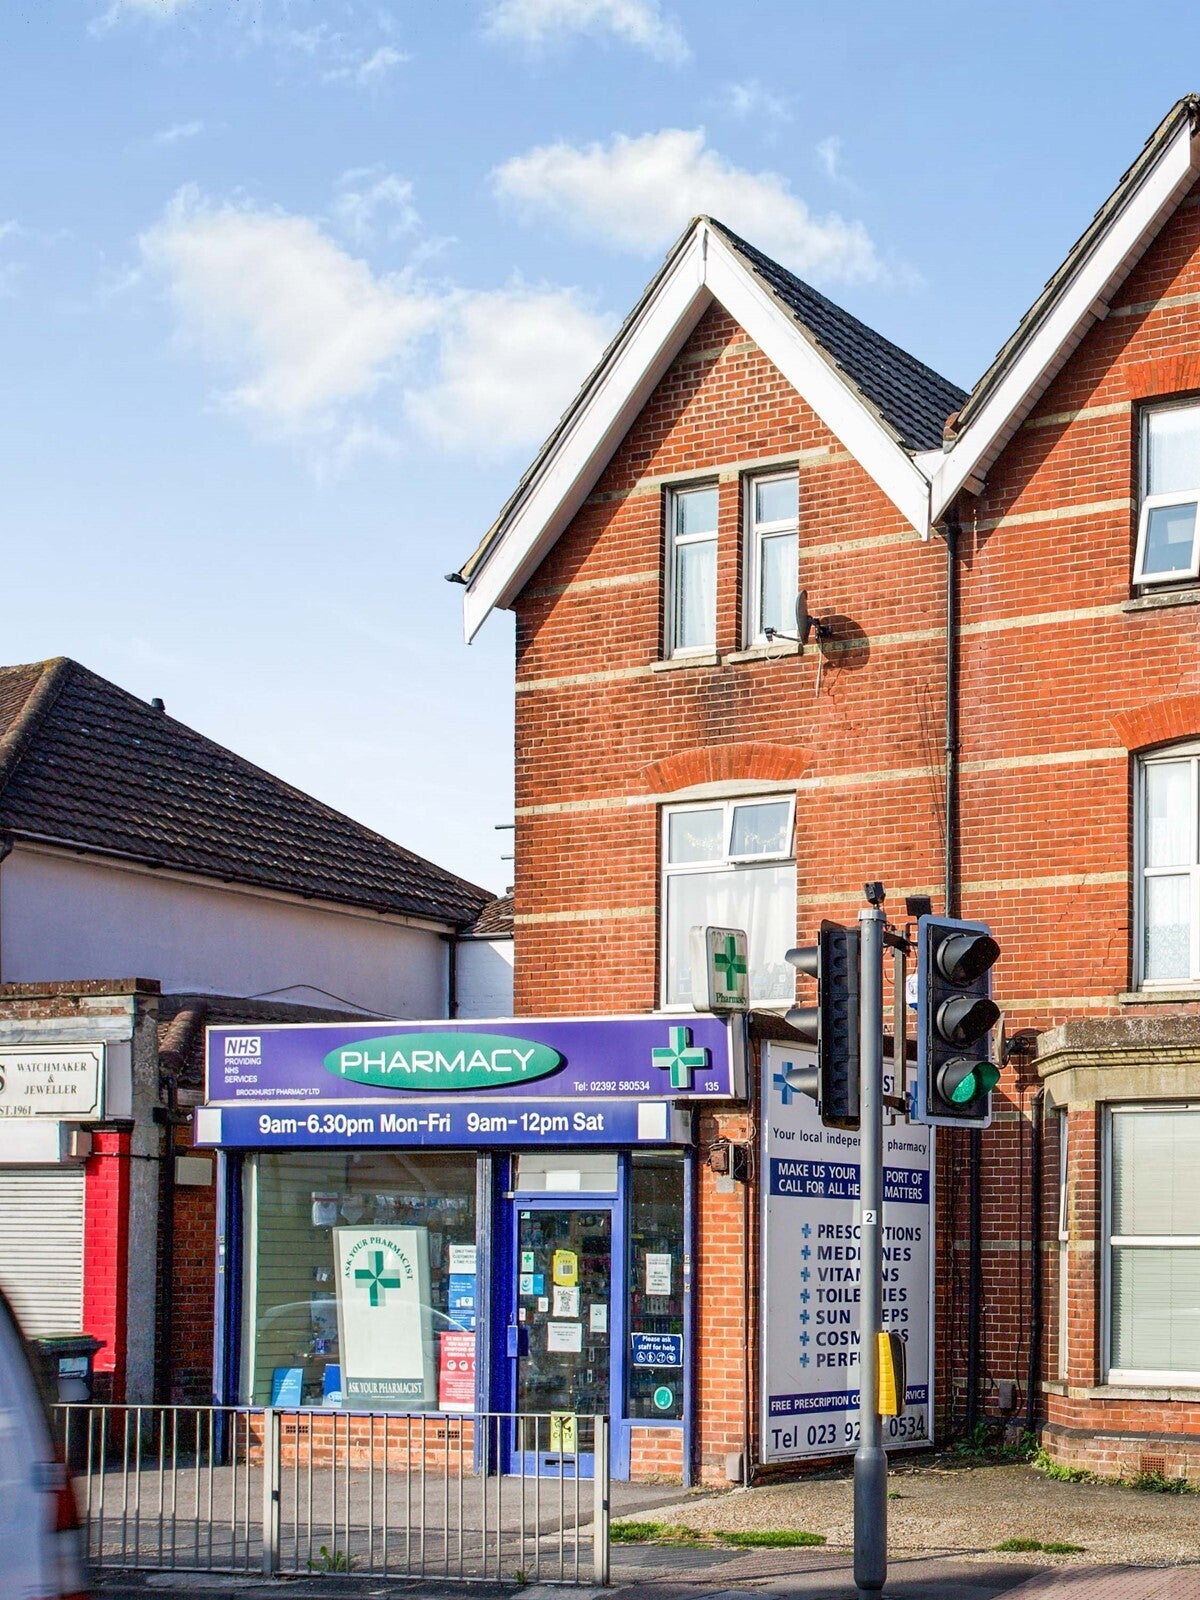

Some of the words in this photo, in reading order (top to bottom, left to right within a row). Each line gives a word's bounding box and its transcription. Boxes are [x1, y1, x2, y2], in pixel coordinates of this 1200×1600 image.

[715, 992, 747, 1006] Pharmacy
[227, 1039, 258, 1054] NHS
[17, 1062, 87, 1072] WATCHMAKER
[340, 1048, 536, 1074] PHARMACY
[48, 1074, 54, 1083] &
[224, 1075, 258, 1083] SERVICES
[24, 1085, 77, 1095] JEWELLER
[236, 1088, 276, 1096] BROCKHURST
[276, 1088, 309, 1096] PHARMACY
[573, 1082, 588, 1092] Tel:
[590, 1082, 617, 1091] 02392
[618, 1081, 650, 1091] 580534
[704, 1082, 720, 1092] 135
[0, 1105, 32, 1115] ST.1961
[258, 1114, 374, 1137] 9am-6.30pm
[380, 1113, 451, 1133] Mon-Fri
[573, 1112, 604, 1131] Sat
[772, 1127, 795, 1141] Your
[800, 1130, 823, 1143] local
[827, 1132, 861, 1148] indepe
[887, 1139, 927, 1154] pharmacy
[778, 1163, 809, 1177] MAKE
[812, 1165, 825, 1178] US
[829, 1166, 856, 1180] YOUR
[886, 1170, 908, 1183] PORT
[911, 1172, 923, 1184] OF
[778, 1179, 803, 1192] CALL
[806, 1180, 825, 1194] FOR
[828, 1183, 845, 1195] ALL
[884, 1185, 923, 1200] MATTERS
[866, 1212, 873, 1222] 2
[817, 1224, 921, 1241] PRESCTIONS
[350, 1238, 368, 1259] YOUR
[370, 1236, 414, 1280] PHARMACIST
[817, 1245, 911, 1261] MEDINES
[817, 1267, 899, 1282] VITANS
[816, 1288, 907, 1303] TOILEIES
[816, 1309, 851, 1325] SUN
[642, 1335, 660, 1343] Please
[662, 1344, 675, 1352] help
[348, 1382, 360, 1393] ASK
[360, 1382, 378, 1394] YOUR
[379, 1382, 423, 1394] PHARMACIST
[771, 1400, 791, 1411] FREE
[794, 1395, 849, 1410] PRESCRIPTION
[905, 1389, 926, 1400] RVICE
[772, 1426, 798, 1449] Tel
[807, 1423, 837, 1446] 023
[889, 1415, 925, 1437] 0534
